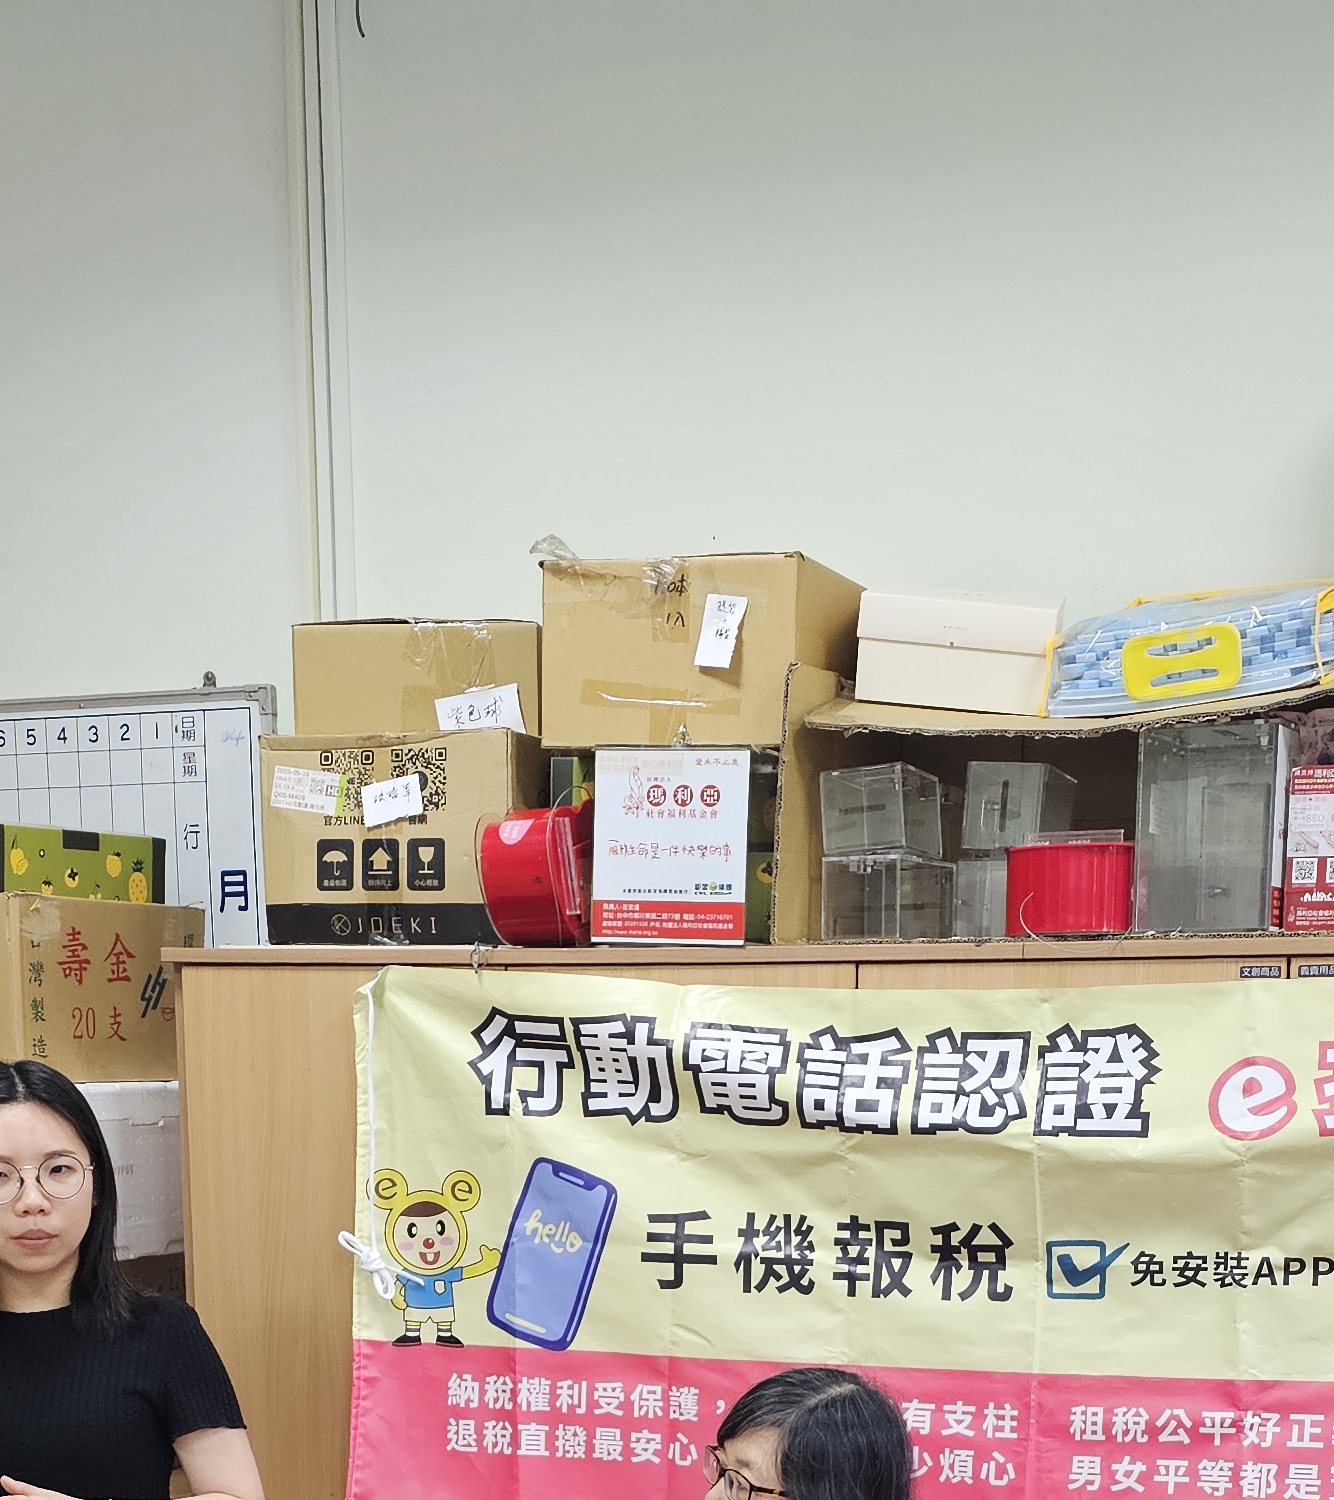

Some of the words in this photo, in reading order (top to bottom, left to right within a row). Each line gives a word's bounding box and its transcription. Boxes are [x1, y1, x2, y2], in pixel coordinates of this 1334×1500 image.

[26, 728, 37, 745] 5
[57, 727, 68, 744] 4
[88, 725, 99, 743] 3
[119, 723, 130, 742] 2
[154, 722, 159, 739] 1
[181, 716, 196, 742] 日期
[646, 809, 718, 819] 社會福利基金會
[648, 786, 719, 804] 瑪利亞
[183, 823, 201, 850] 行
[220, 869, 249, 913] 月
[57, 926, 137, 986] 壽金
[1242, 966, 1280, 977] 文創商品
[72, 1006, 128, 1042] 20支
[468, 1006, 1163, 1139] 行動電話認證
[524, 1209, 583, 1253] hello
[641, 1211, 1014, 1303] 手機報稅
[446, 1417, 699, 1469] 退稅直撥最安心
